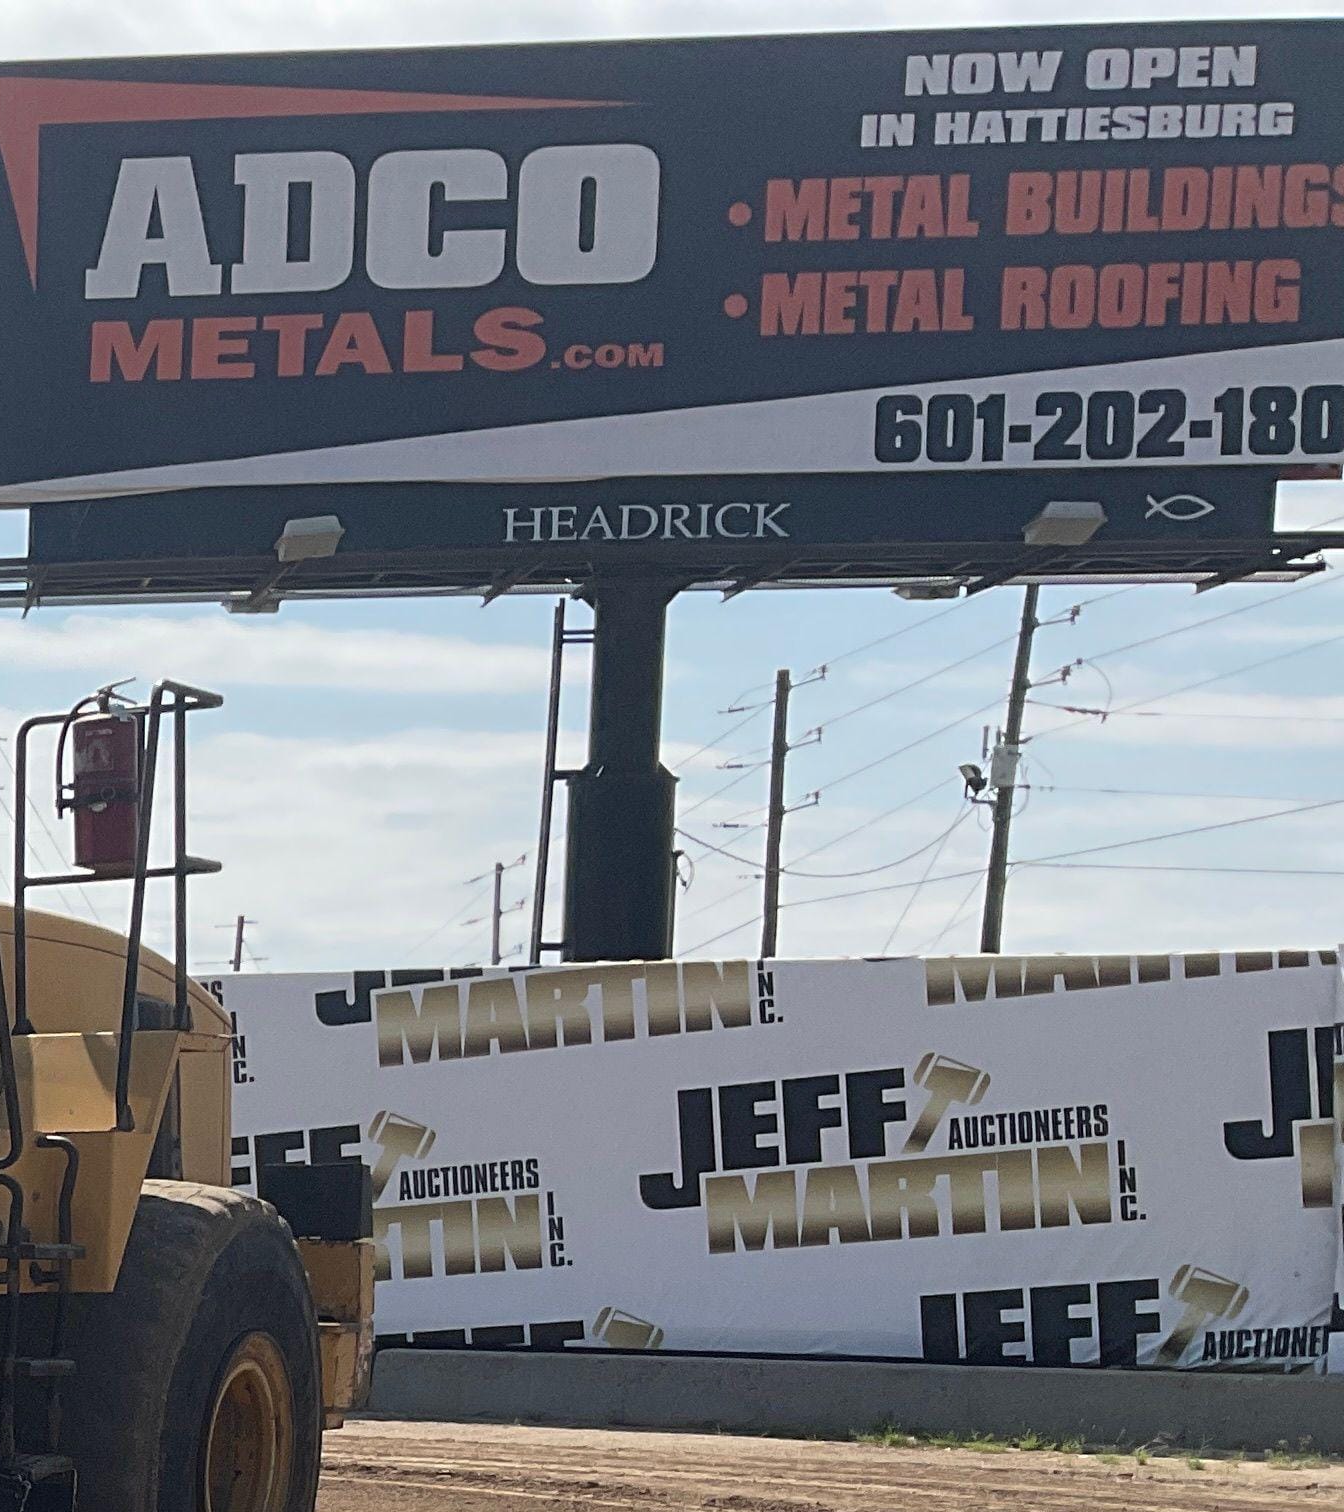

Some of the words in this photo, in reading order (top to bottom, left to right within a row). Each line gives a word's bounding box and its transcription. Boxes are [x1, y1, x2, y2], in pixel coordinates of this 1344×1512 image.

[904, 50, 1063, 97] NOW
[1085, 45, 1257, 91] OPEN
[860, 113, 915, 148] IN
[934, 102, 1295, 146] HATTIESBURG
[85, 143, 660, 299] ADCO
[764, 174, 980, 242] METAL
[1006, 164, 1344, 237] BUILDING
[760, 268, 974, 336] METAL
[1001, 259, 1302, 332] ROOFING
[874, 384, 1344, 464] 601-202-180
[502, 502, 791, 542] HEADRICK
[376, 960, 752, 1068] MARTIN
[639, 1068, 907, 1211] JEFF
[948, 1104, 1109, 1150] AUCTIONEERS
[399, 1158, 540, 1201] AUCTIONEERS
[705, 1142, 1112, 1255] MARTIN
[1117, 1140, 1147, 1222] INC.
[546, 1191, 573, 1267] INC.
